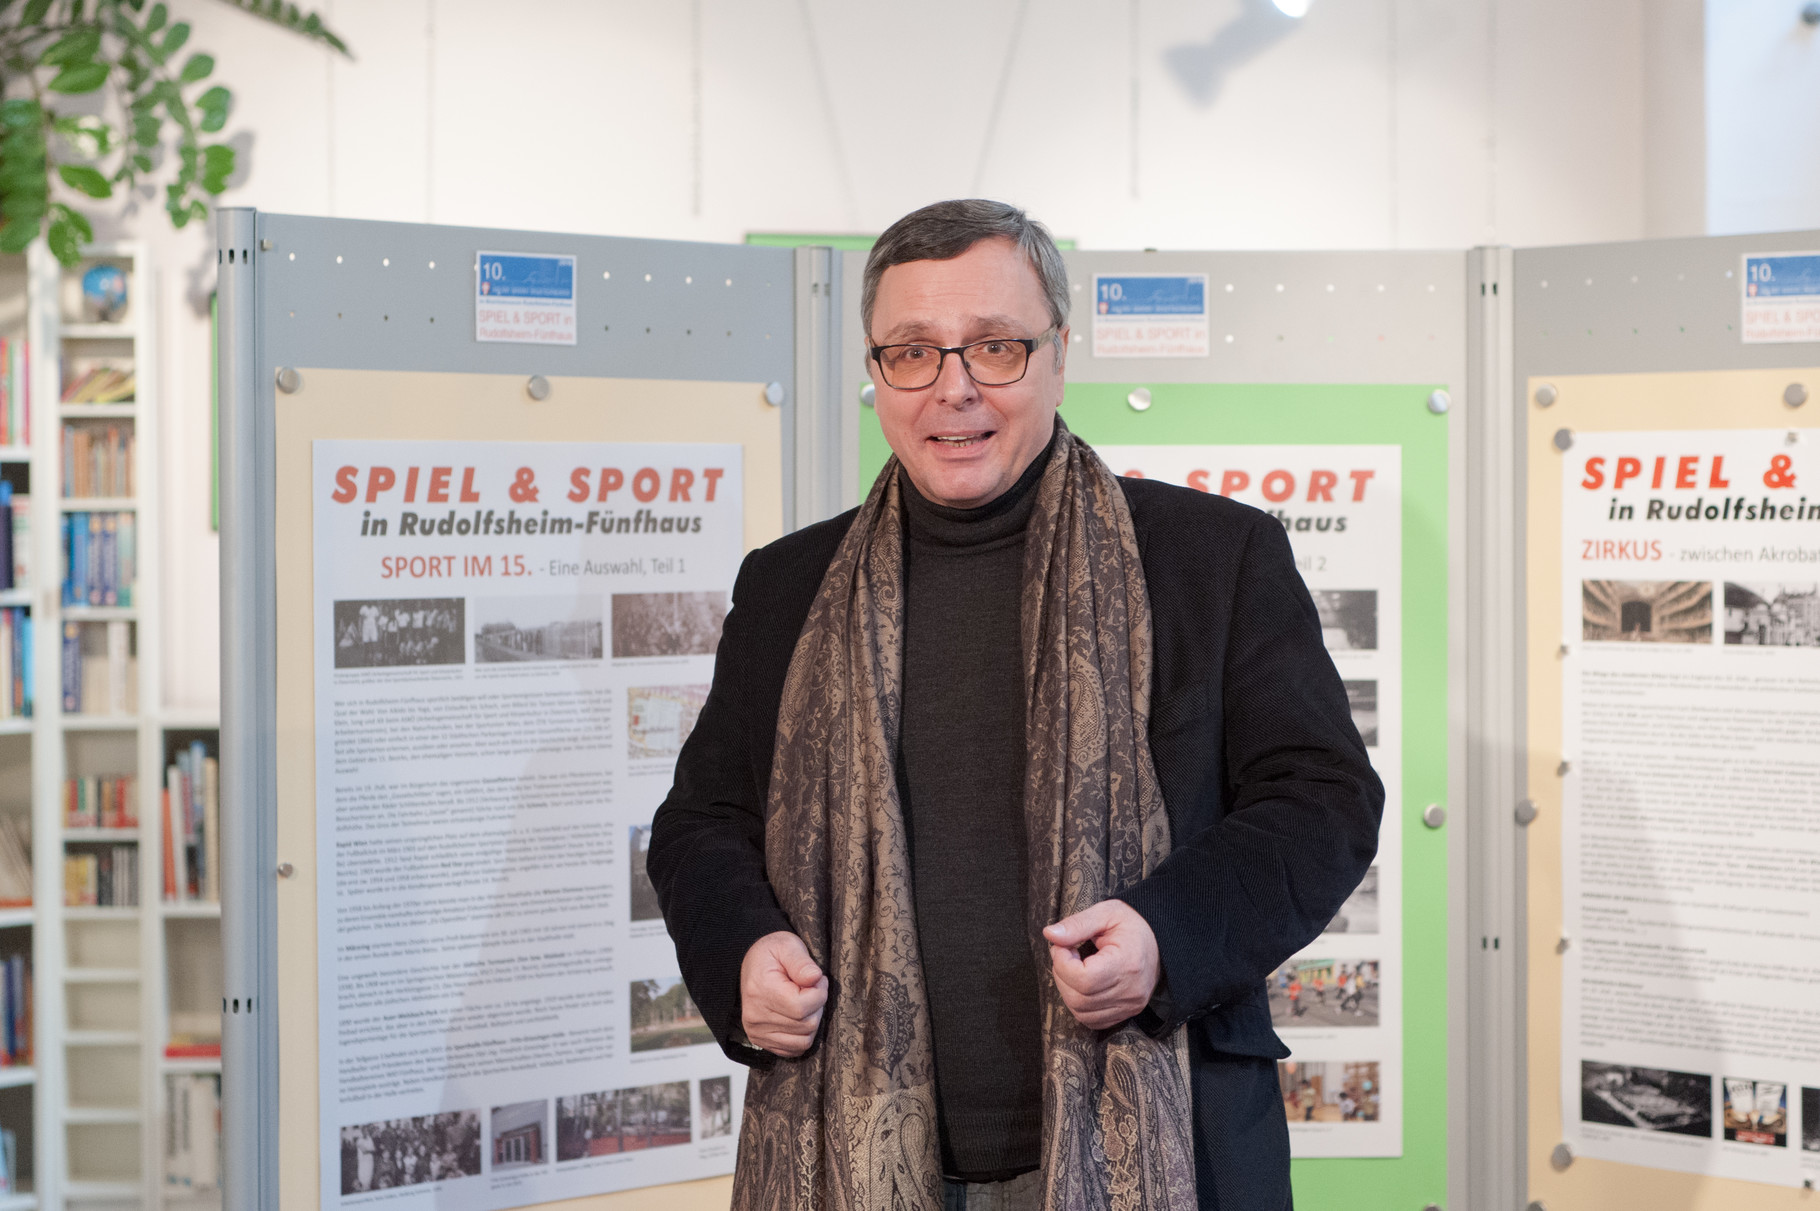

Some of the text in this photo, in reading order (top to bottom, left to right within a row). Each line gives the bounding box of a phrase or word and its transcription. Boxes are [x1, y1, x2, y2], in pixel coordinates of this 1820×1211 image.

[483, 262, 506, 281] 10.
[1750, 263, 1776, 282] 10.
[1100, 283, 1127, 301] 10.
[479, 309, 511, 325] SPIEL
[524, 311, 562, 326] SPORT
[1581, 454, 1797, 490] SPIEL &
[332, 466, 724, 504] SPIEL & SPORT
[1186, 470, 1375, 503] SPORT
[1609, 497, 1634, 520] in
[361, 510, 702, 537] in Rudolfsheim-Fünfhaus
[1581, 540, 1663, 561] ZIRKUS
[1680, 547, 1754, 563] zwischen
[1759, 546, 1820, 563] Akroba
[382, 556, 456, 579] SPORT
[464, 555, 493, 578] IM
[501, 554, 532, 577] 15.
[549, 559, 580, 576] Eine
[584, 558, 647, 577] Auswahl,
[650, 558, 675, 575] Teil
[679, 559, 685, 575] 1
[1318, 556, 1327, 571] 2
